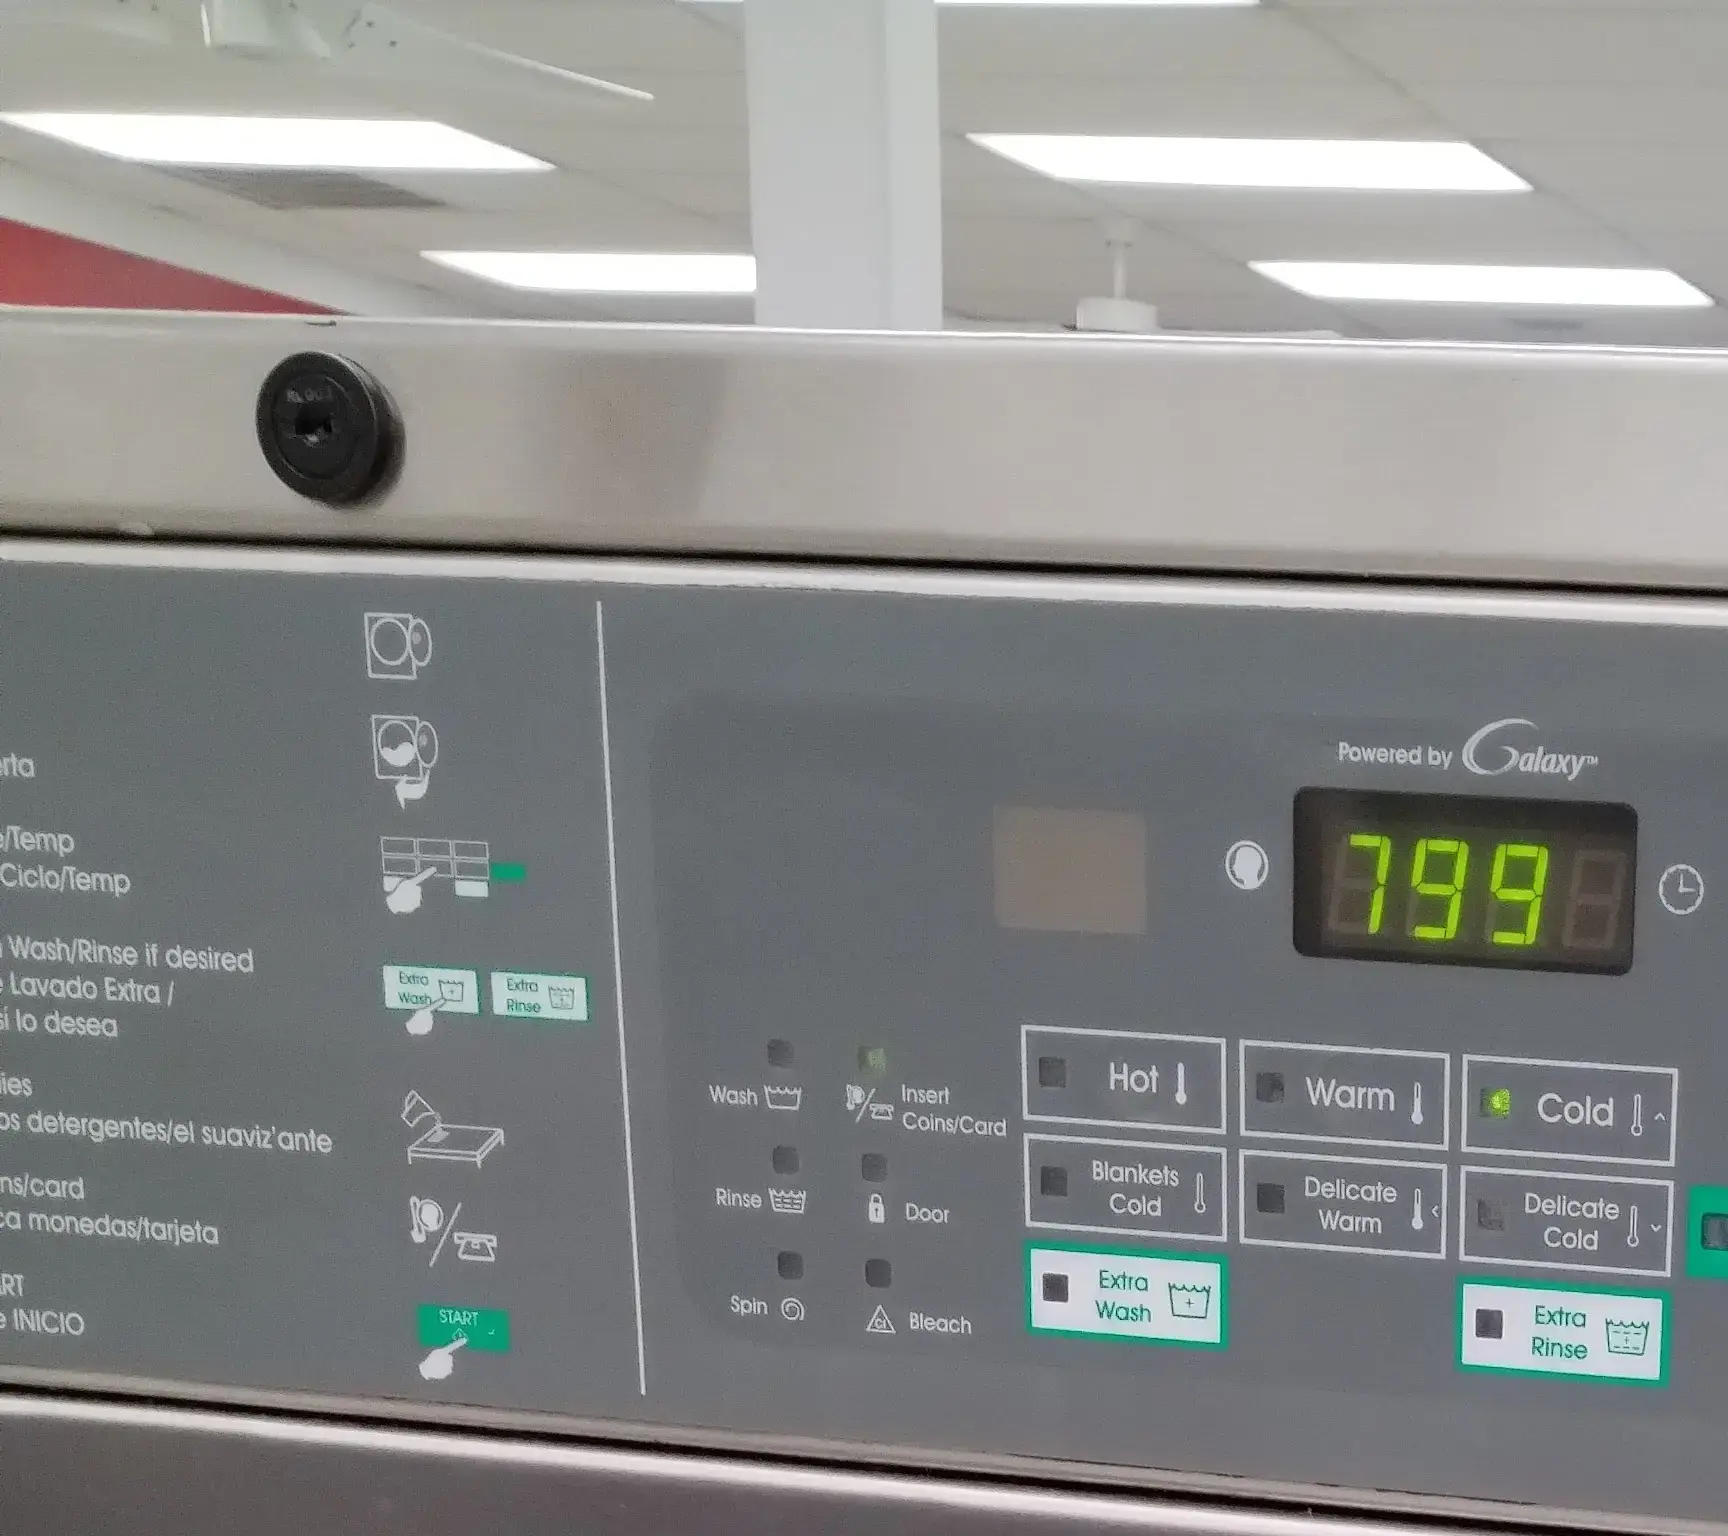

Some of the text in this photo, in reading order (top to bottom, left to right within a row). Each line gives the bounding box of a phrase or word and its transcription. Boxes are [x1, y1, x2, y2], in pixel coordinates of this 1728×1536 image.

[1338, 741, 1422, 766] Powered
[1428, 746, 1453, 770] by
[0, 862, 131, 898] Ciclo/Temp
[1350, 834, 1549, 945] 799
[8, 934, 255, 973] Wash/Rinse if desired
[10, 971, 98, 1000] Lavado
[104, 977, 161, 1004] Extra
[399, 971, 430, 987] Extra
[507, 978, 539, 994] Extra
[397, 992, 433, 1007] Wash
[507, 997, 542, 1014] Rinse
[15, 1008, 38, 1033] lo
[44, 1010, 119, 1039] desea
[1109, 1061, 1160, 1094] Hot
[709, 1084, 759, 1107] Wash
[901, 1084, 951, 1106] Insert
[1305, 1076, 1396, 1112] Warm
[1536, 1092, 1615, 1127] Cold
[27, 1110, 195, 1143] detergentes/el
[902, 1111, 1007, 1137] Coins/Card
[1091, 1159, 1180, 1188] Blankets
[716, 1187, 762, 1209] Rinse
[1304, 1175, 1398, 1204] Delicate
[905, 1202, 951, 1225] Door
[1109, 1193, 1162, 1218] Cold
[1524, 1192, 1620, 1221] Delicate
[28, 1213, 219, 1246] monedas/tarjeta
[1318, 1208, 1383, 1235] Warm
[1543, 1226, 1599, 1252] Cold
[1099, 1269, 1150, 1293] Extra
[438, 1307, 479, 1328] START
[730, 1294, 768, 1317] Spin
[1095, 1300, 1152, 1323] Wash
[1534, 1304, 1587, 1328] Extra
[13, 1307, 86, 1336] INICIO
[909, 1311, 973, 1335] Bleach
[1531, 1336, 1588, 1361] Rinse
